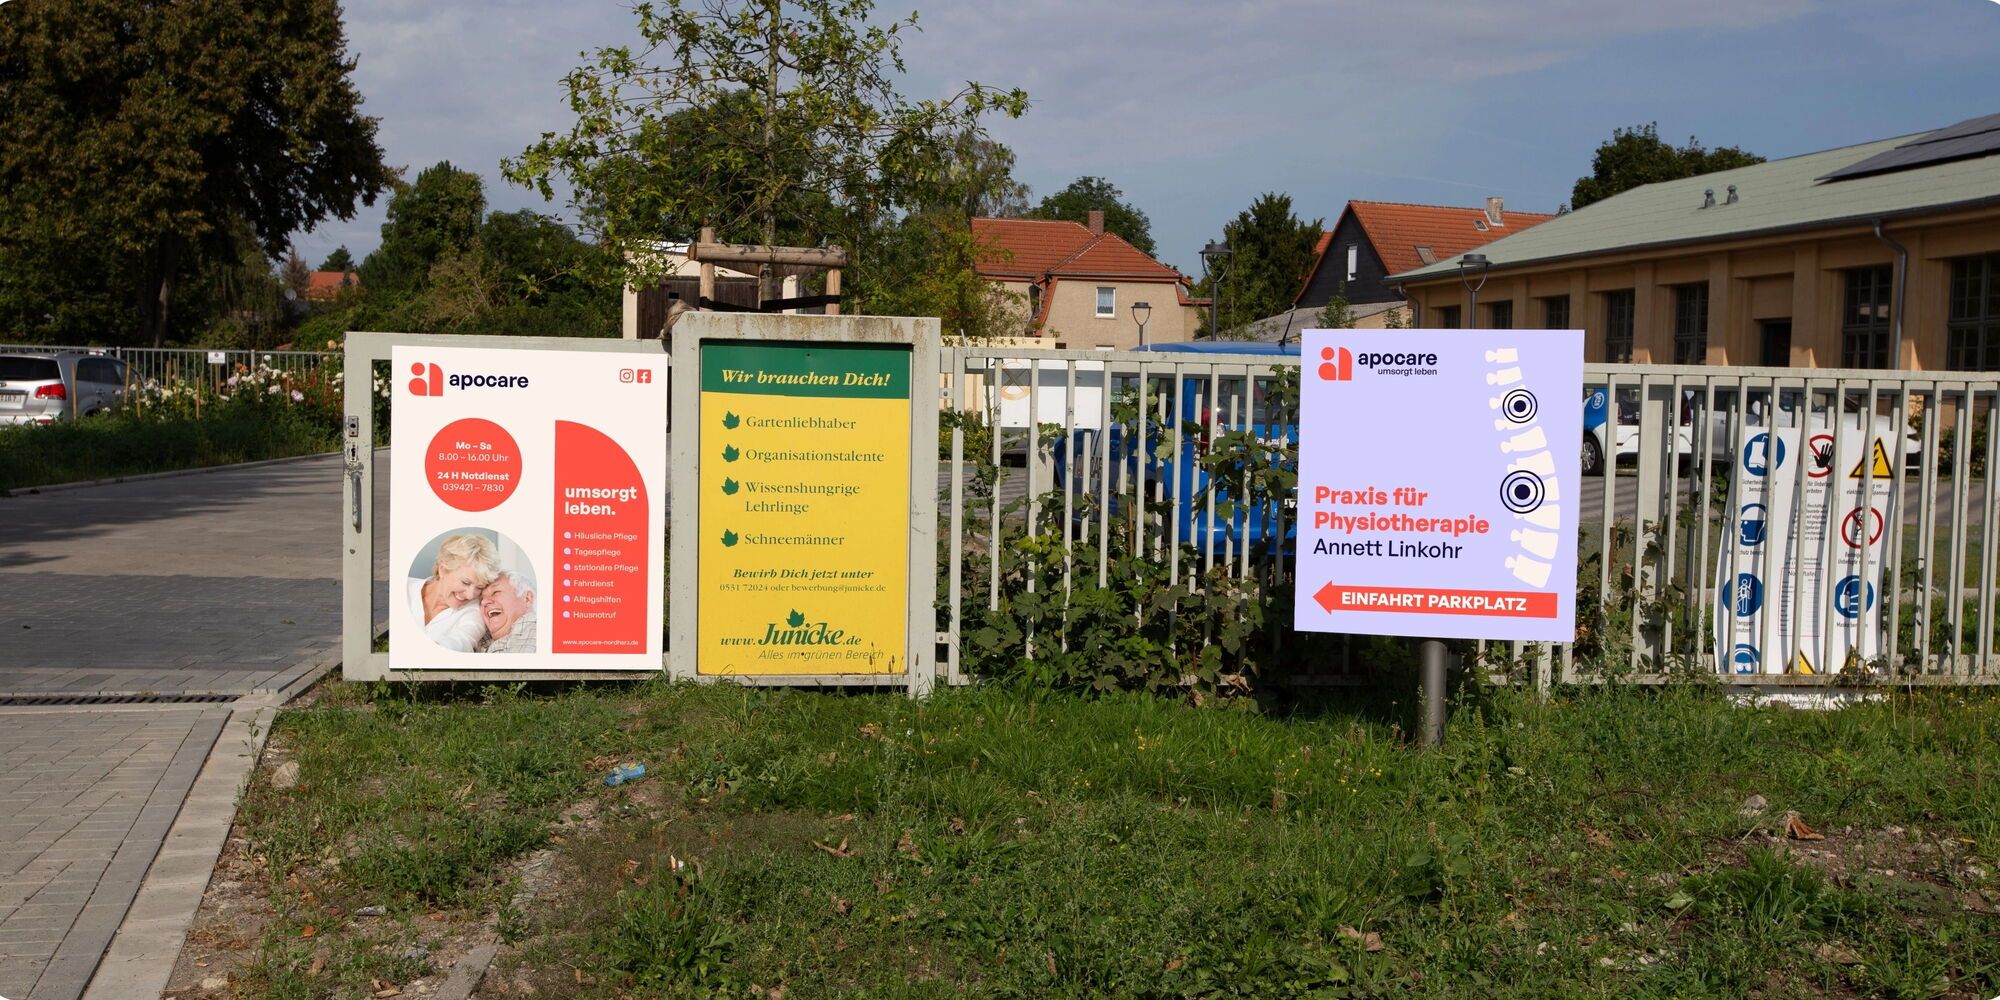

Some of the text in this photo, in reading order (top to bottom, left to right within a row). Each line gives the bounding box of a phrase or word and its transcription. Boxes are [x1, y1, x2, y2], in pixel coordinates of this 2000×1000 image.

[1358, 353, 1437, 369] apocare
[722, 370, 890, 386] Wir brauchen Dich!
[1378, 368, 1412, 376] umsorgt
[449, 374, 528, 390] apocare
[747, 417, 856, 429] Gartenliebhaber
[480, 442, 492, 450] Sa
[746, 450, 884, 463] Organisationstalente
[461, 472, 509, 480] Notdienst
[443, 483, 473, 491] 039421
[482, 484, 504, 492] 7830
[746, 482, 860, 496] Wissenshungrige
[565, 487, 637, 502] umsorgt
[1315, 486, 1388, 505] Praxis
[1393, 488, 1428, 506] für
[565, 501, 616, 515] leben.
[746, 501, 808, 514] Lehrlinge
[1315, 512, 1489, 537] Physiotherapie
[612, 533, 637, 541] Pflege
[745, 534, 844, 545] Schneemänner
[574, 548, 621, 557] Tagespflege
[1314, 539, 1462, 558] Annett Linkohr
[613, 564, 638, 573] Pflege
[734, 569, 777, 578] Bewirb
[781, 569, 808, 578] Dich
[809, 570, 837, 580] jetzt
[792, 584, 886, 592] bewerbung@junicke.de
[573, 596, 621, 604] Alltagshilfen
[1342, 592, 1527, 611] EINFAHRT PARKPLATZ
[758, 648, 883, 662] Alles im grünen Bereich
